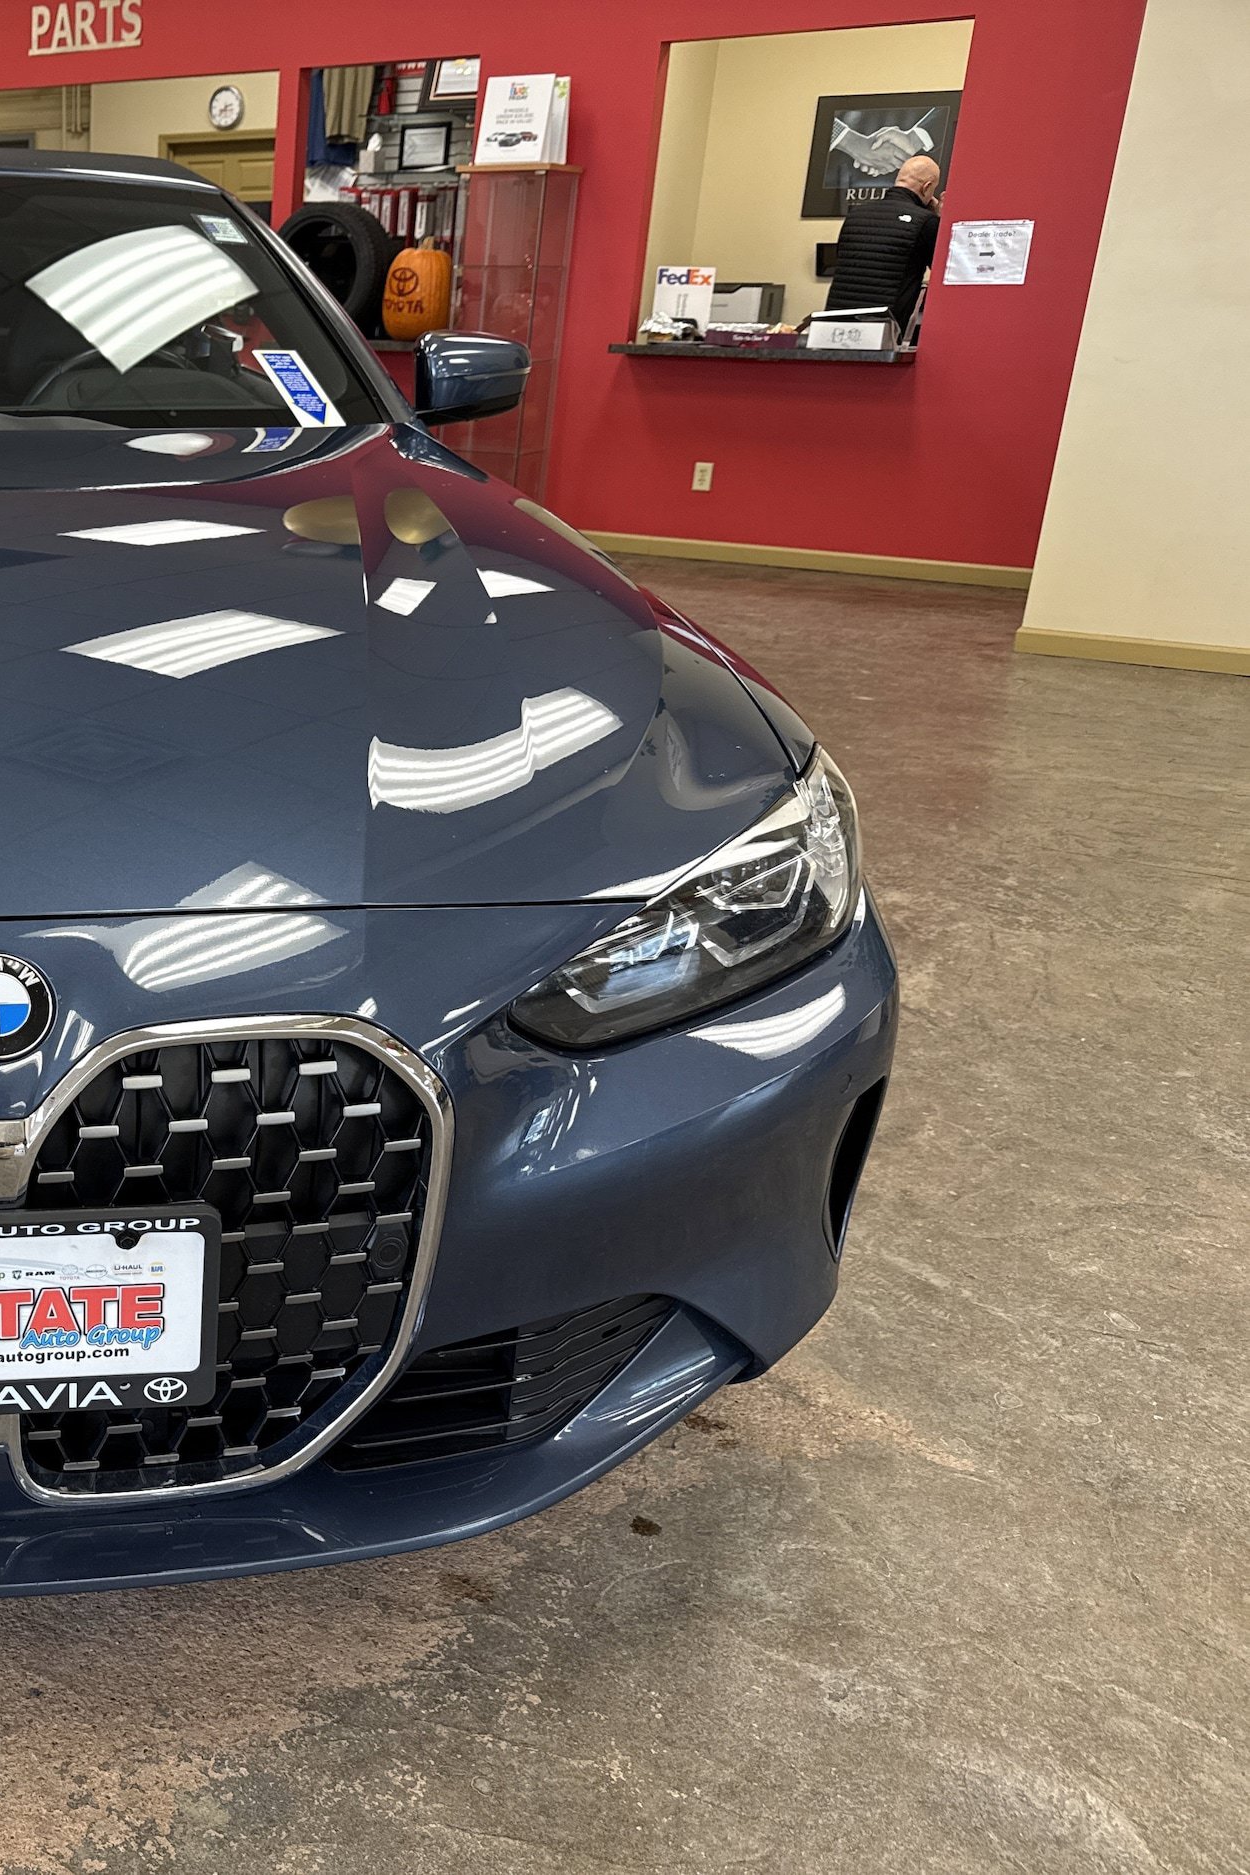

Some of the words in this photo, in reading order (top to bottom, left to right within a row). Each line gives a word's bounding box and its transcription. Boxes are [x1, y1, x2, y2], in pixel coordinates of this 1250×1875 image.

[31, 0, 142, 51] PARTS
[657, 268, 712, 286] FedEx
[76, 1218, 200, 1233] GROUP
[19, 1326, 81, 1350] Auto
[86, 1323, 163, 1350] Group
